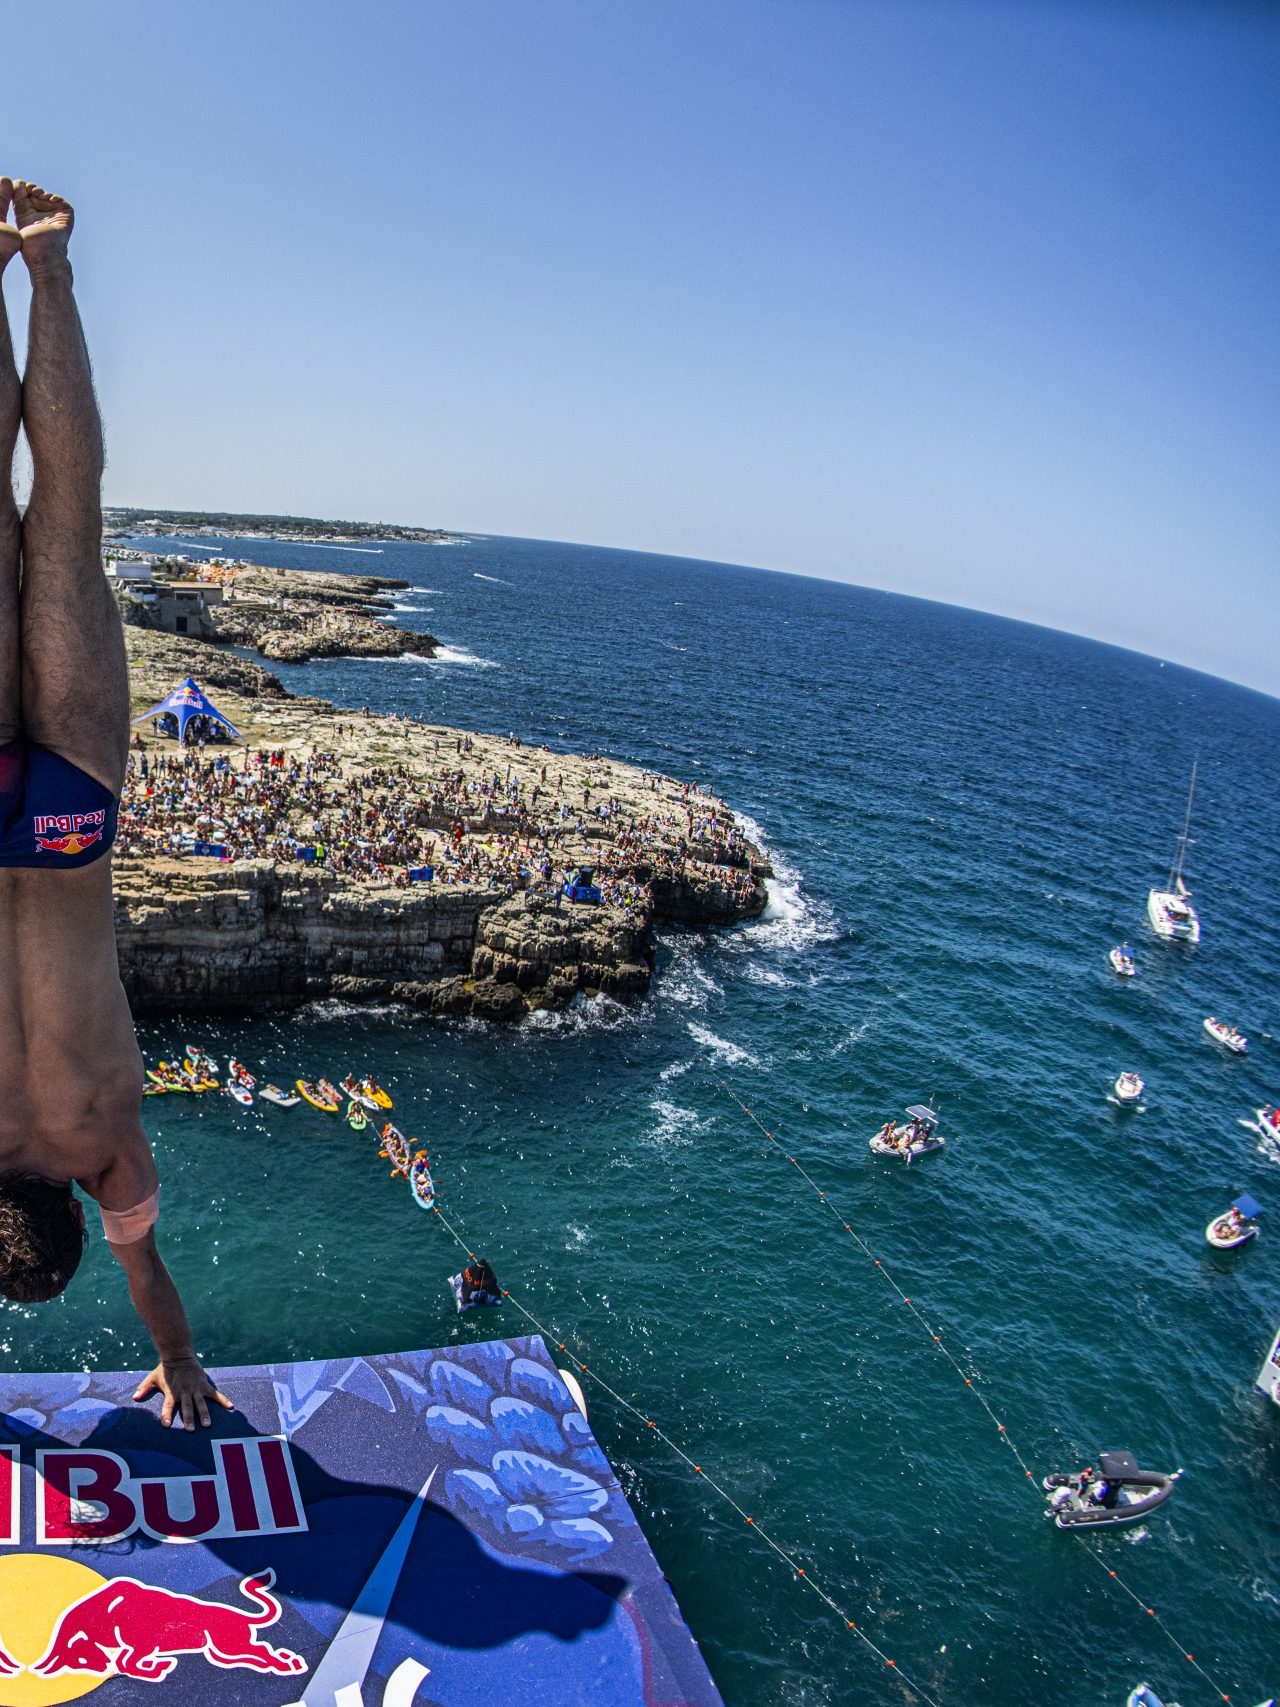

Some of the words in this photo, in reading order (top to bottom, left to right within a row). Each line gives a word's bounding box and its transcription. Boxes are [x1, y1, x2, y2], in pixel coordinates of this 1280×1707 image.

[34, 815, 72, 834] Bull
[72, 809, 105, 831] Red
[36, 1435, 308, 1545] Bull
